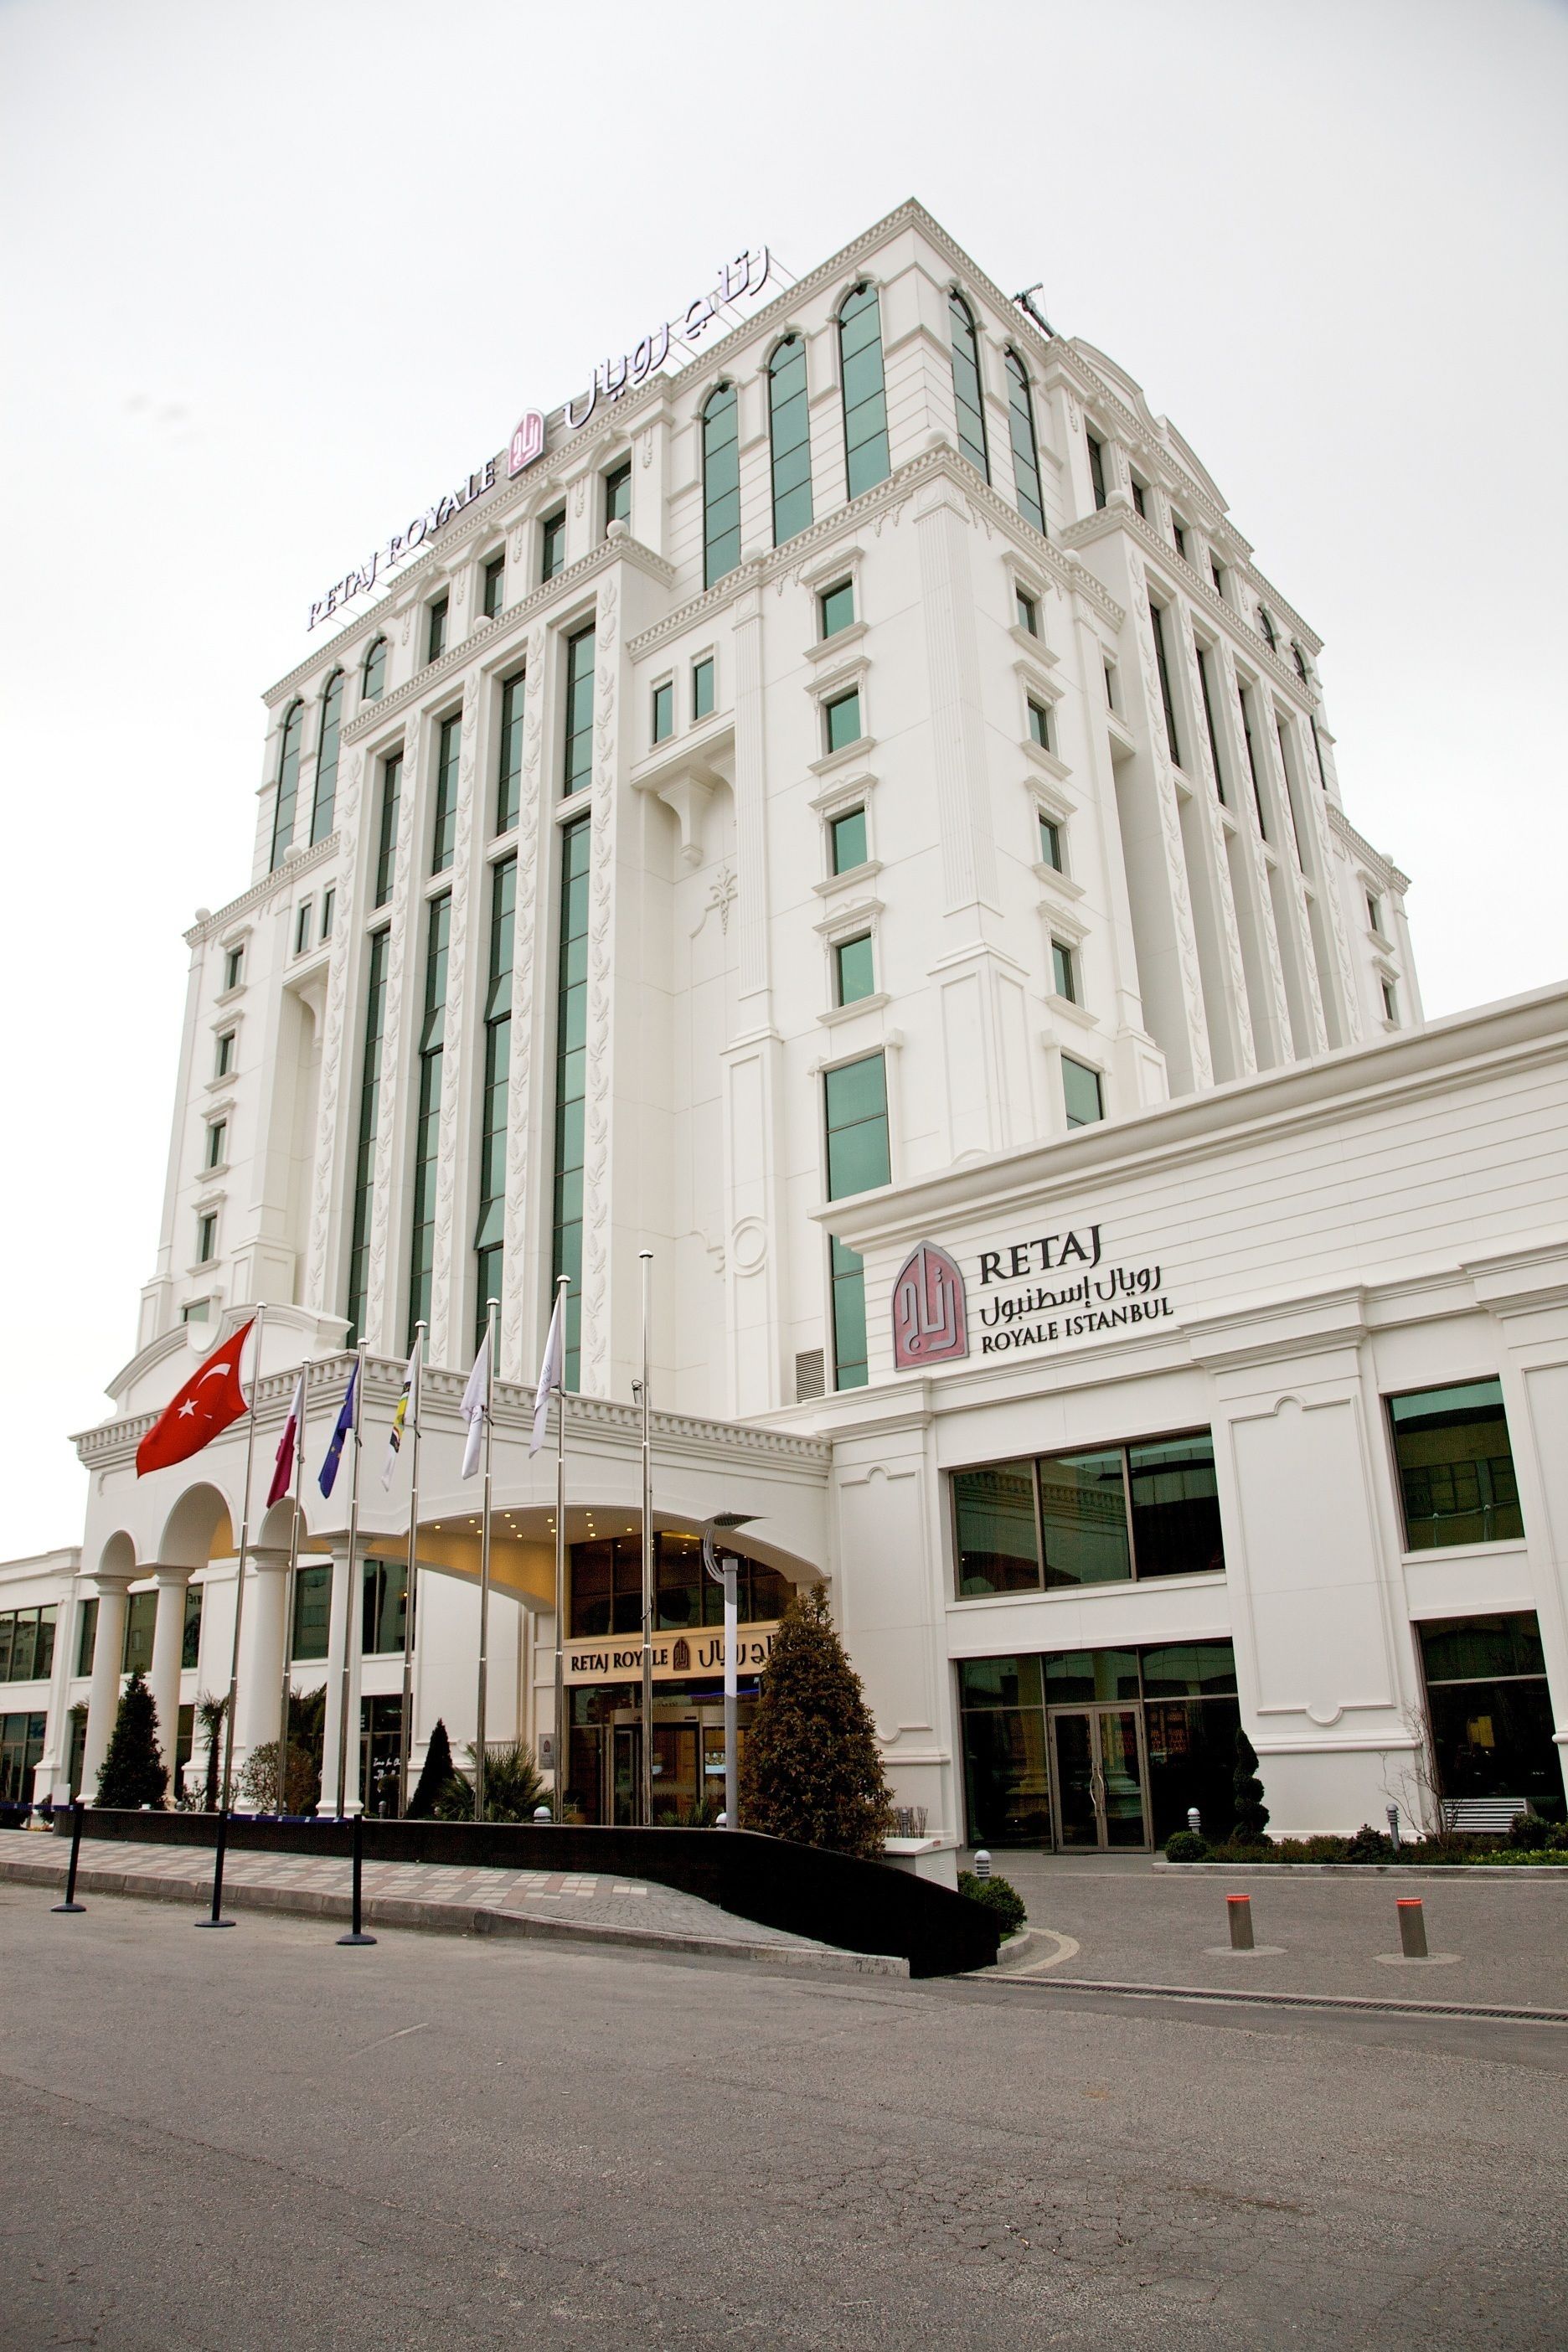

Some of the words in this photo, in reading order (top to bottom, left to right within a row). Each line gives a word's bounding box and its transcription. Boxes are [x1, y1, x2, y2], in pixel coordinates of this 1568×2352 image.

[682, 245, 769, 340] رتاج
[562, 322, 669, 430] رويال
[307, 552, 378, 632] RETAJ
[386, 457, 496, 569] ROYALE
[977, 1224, 1102, 1286] RETAJ
[1095, 1266, 1162, 1301] رويال
[982, 1321, 1059, 1354] ROYALE
[1065, 1297, 1174, 1337] ISTANBUL
[570, 1653, 609, 1674] RETAJ
[613, 1648, 668, 1669] ROYLE
